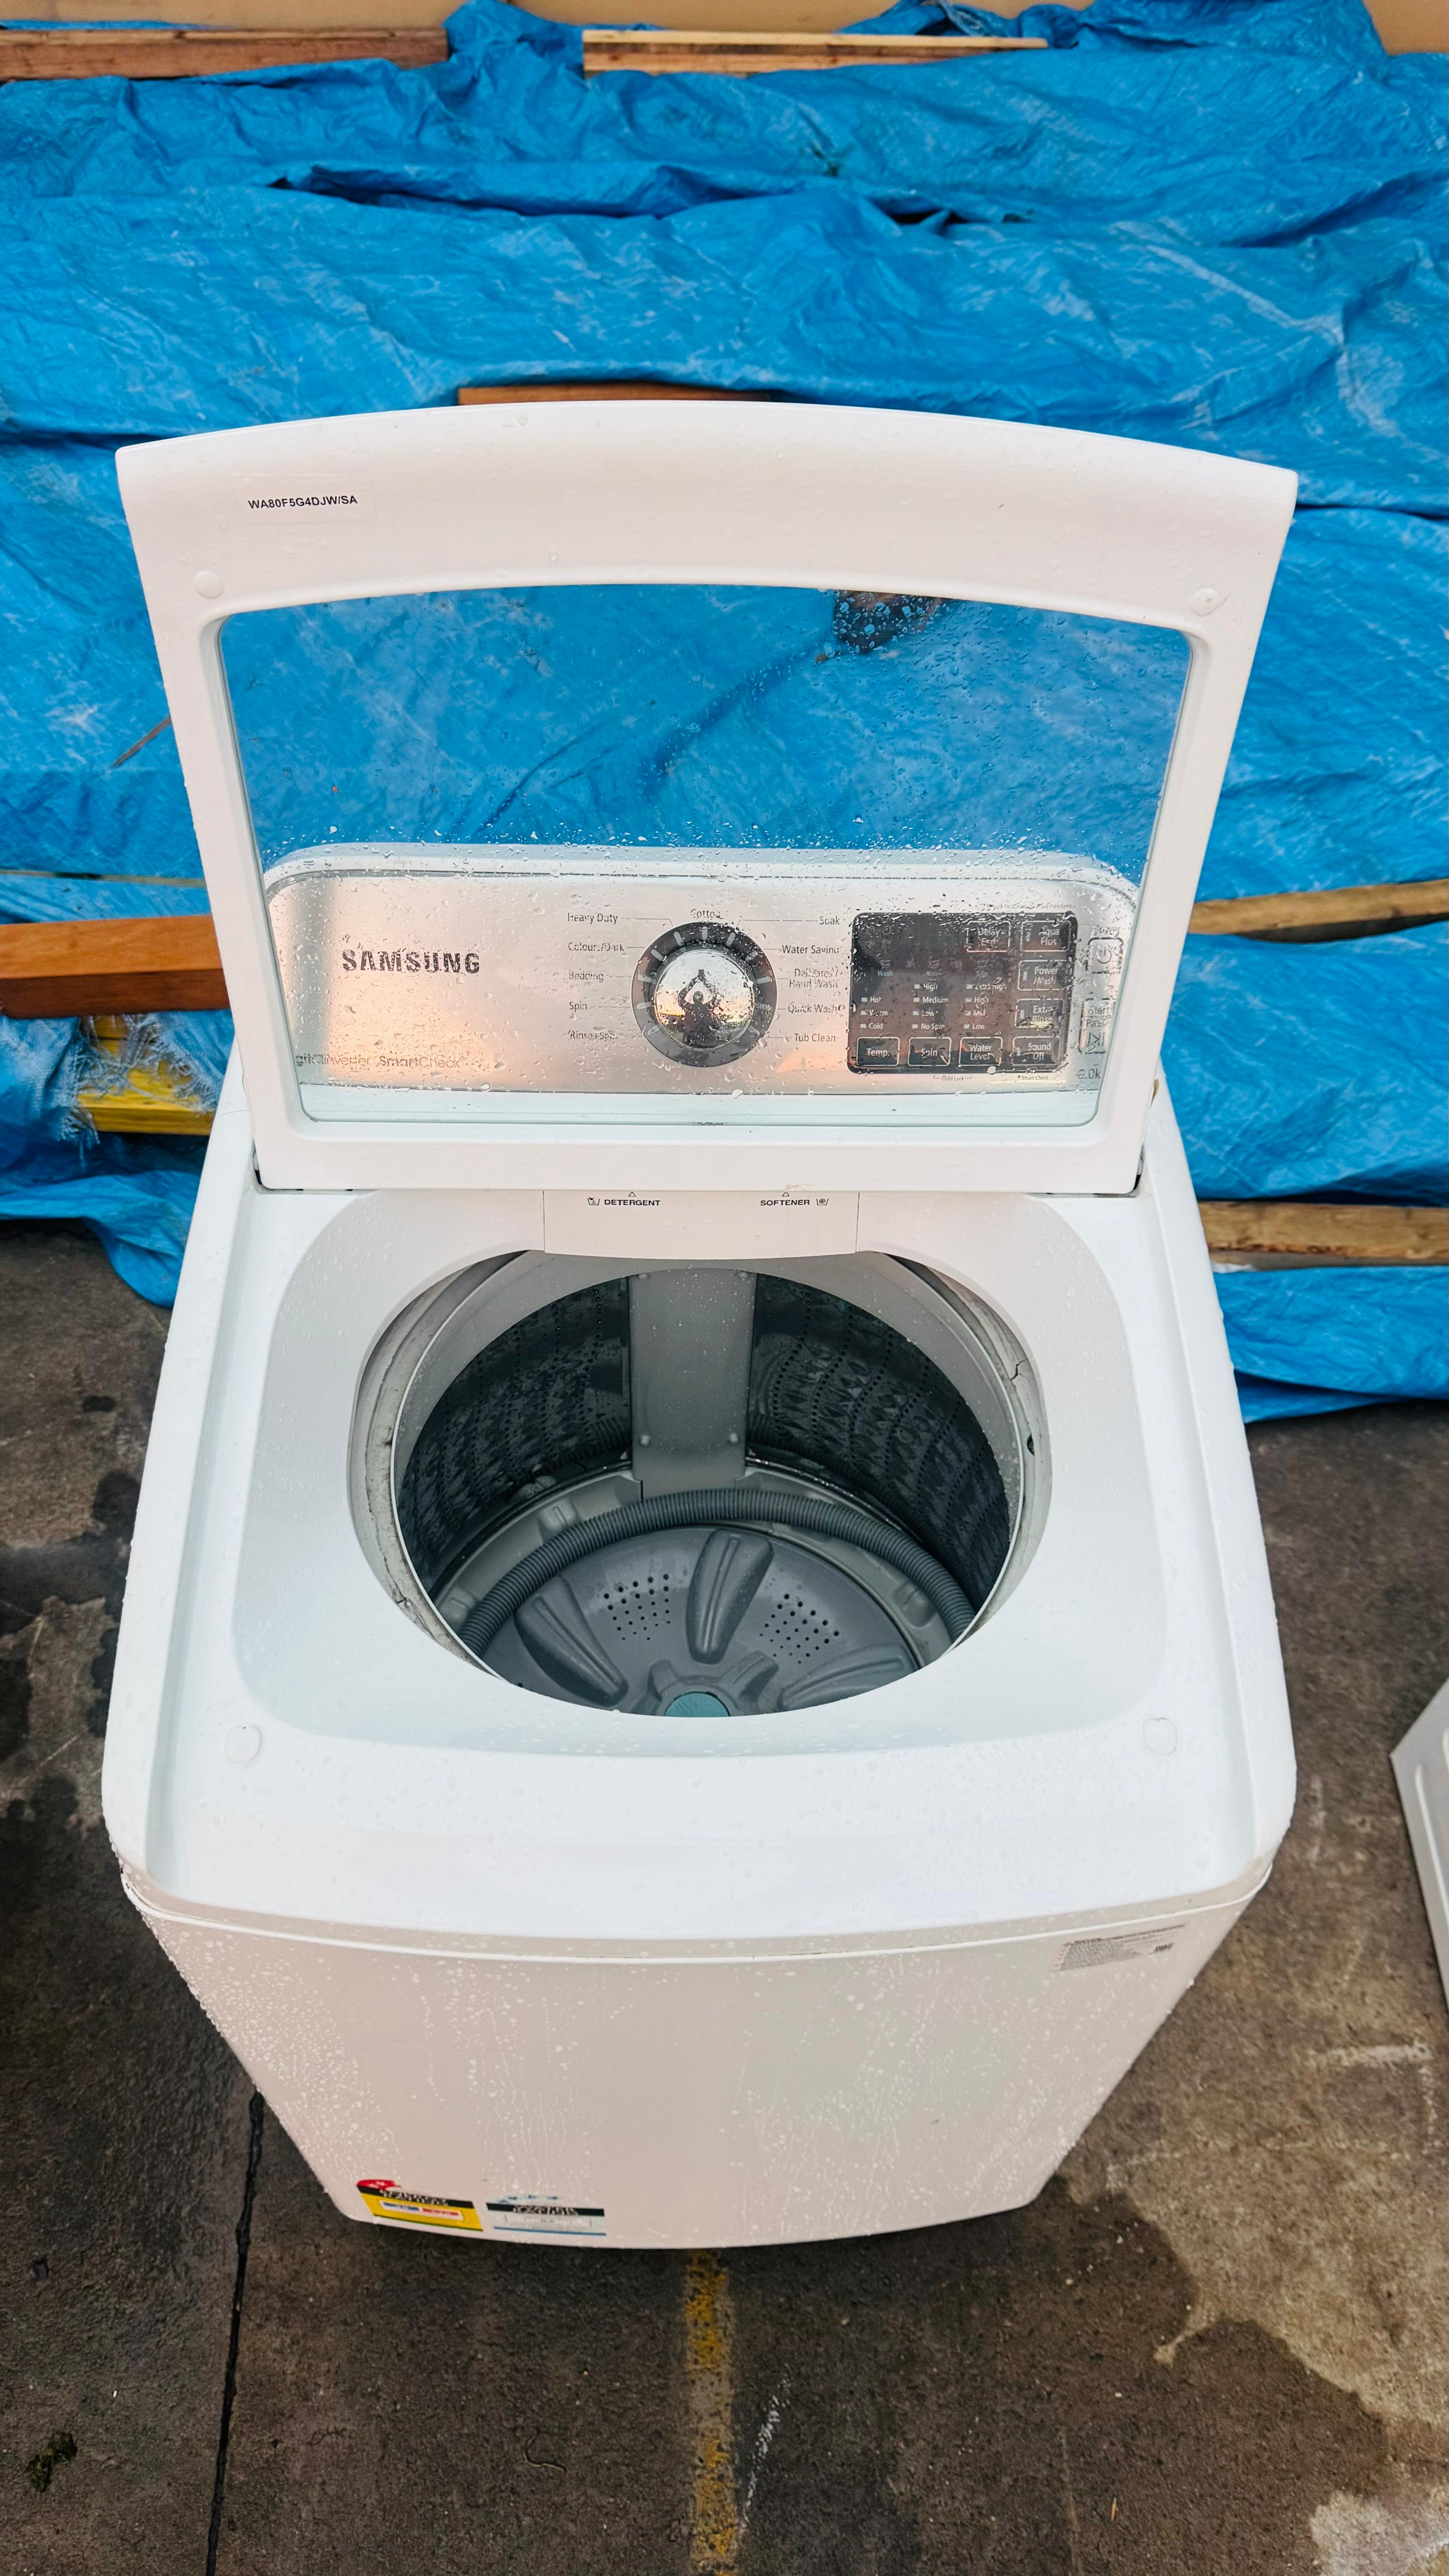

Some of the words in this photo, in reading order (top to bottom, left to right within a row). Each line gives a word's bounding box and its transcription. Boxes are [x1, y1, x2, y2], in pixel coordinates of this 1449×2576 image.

[568, 912, 594, 925] Heavy
[597, 913, 618, 925] Duty
[820, 916, 840, 925] Soak
[782, 945, 809, 954] Water
[342, 949, 479, 974] SAMSUNG
[1034, 966, 1059, 975] Power
[923, 983, 938, 992] High
[569, 1001, 588, 1012] Spin
[788, 1004, 812, 1014] Quick
[814, 1004, 837, 1013] Wash
[931, 1023, 945, 1031] Spin
[794, 1033, 810, 1042] Tub
[812, 1033, 836, 1042] Clean
[970, 1044, 993, 1053] Water
[1028, 1042, 1052, 1051] Sound
[866, 1048, 890, 1058] Temp.
[921, 1048, 938, 1058] Spin
